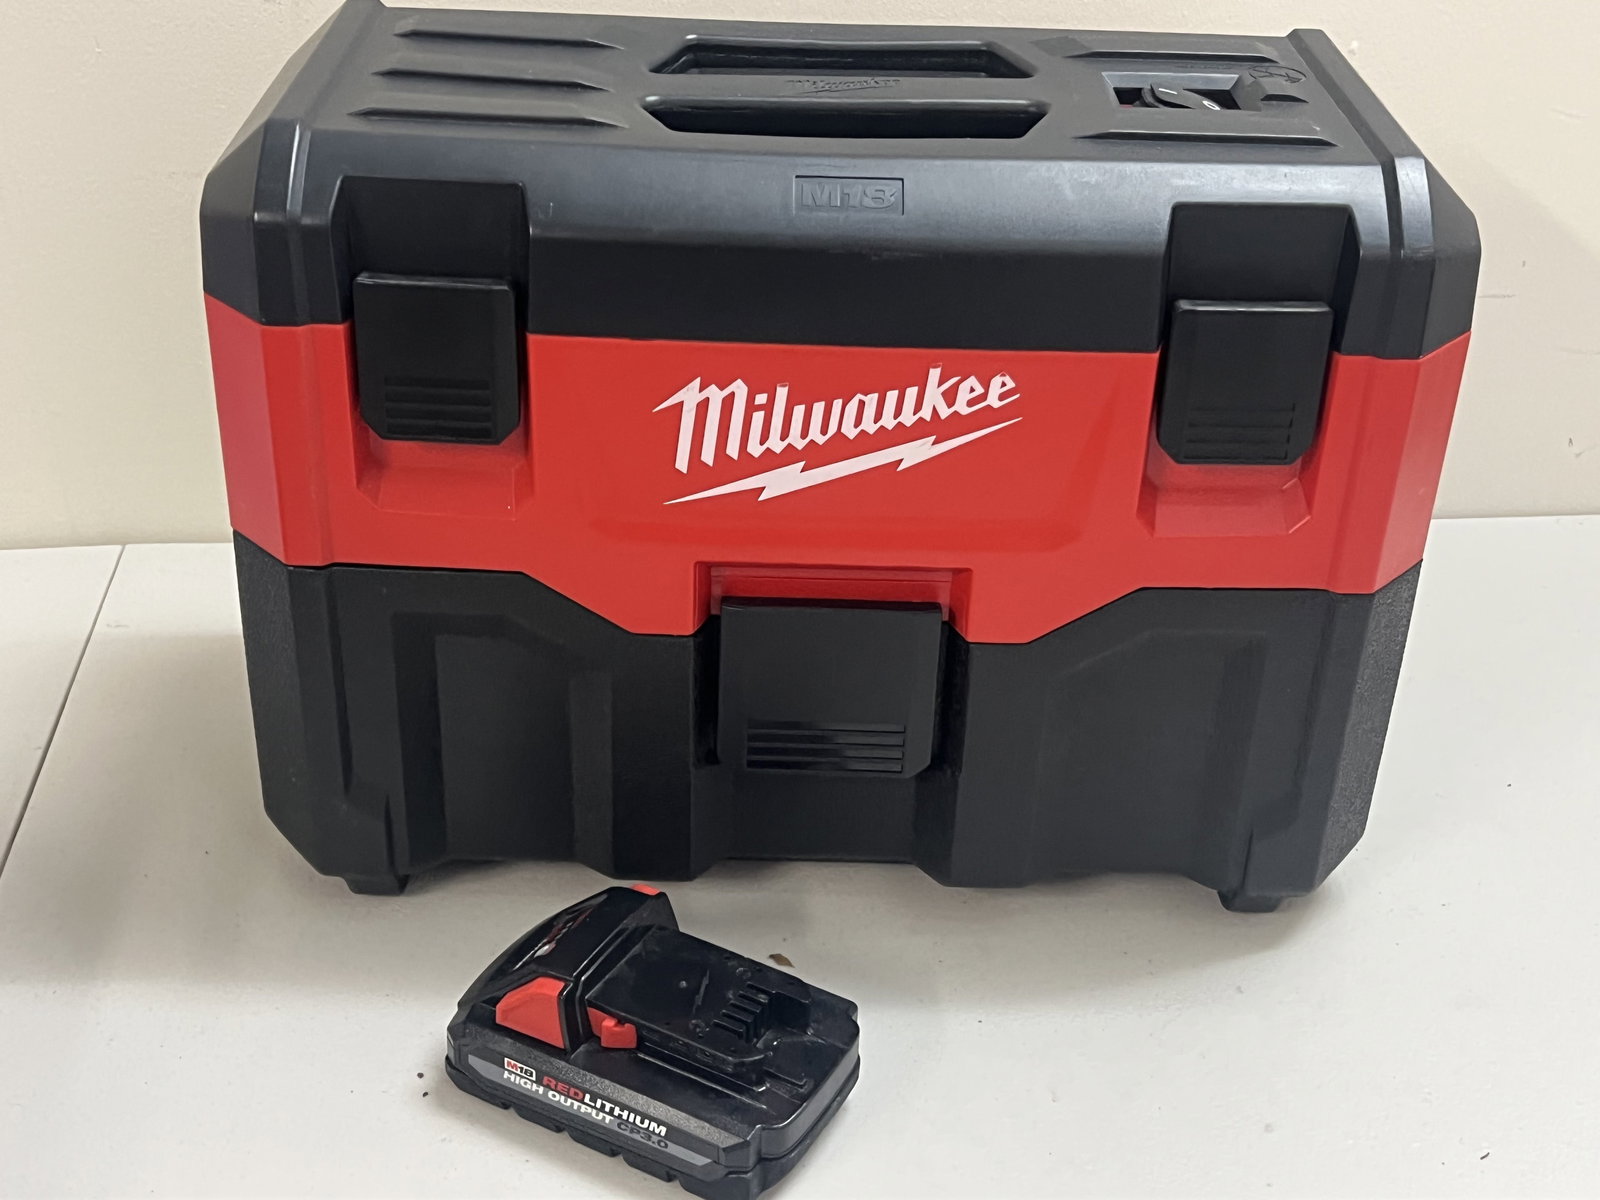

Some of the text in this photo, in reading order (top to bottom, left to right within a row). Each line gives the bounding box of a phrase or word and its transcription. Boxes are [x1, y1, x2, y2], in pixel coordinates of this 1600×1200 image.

[801, 183, 897, 209] M18
[652, 362, 1020, 474] Milwaukee
[506, 1060, 534, 1079] M18
[503, 1071, 668, 1150] HIGH OUTPUT CP3.0
[542, 1075, 667, 1137] REDLITHIUM
